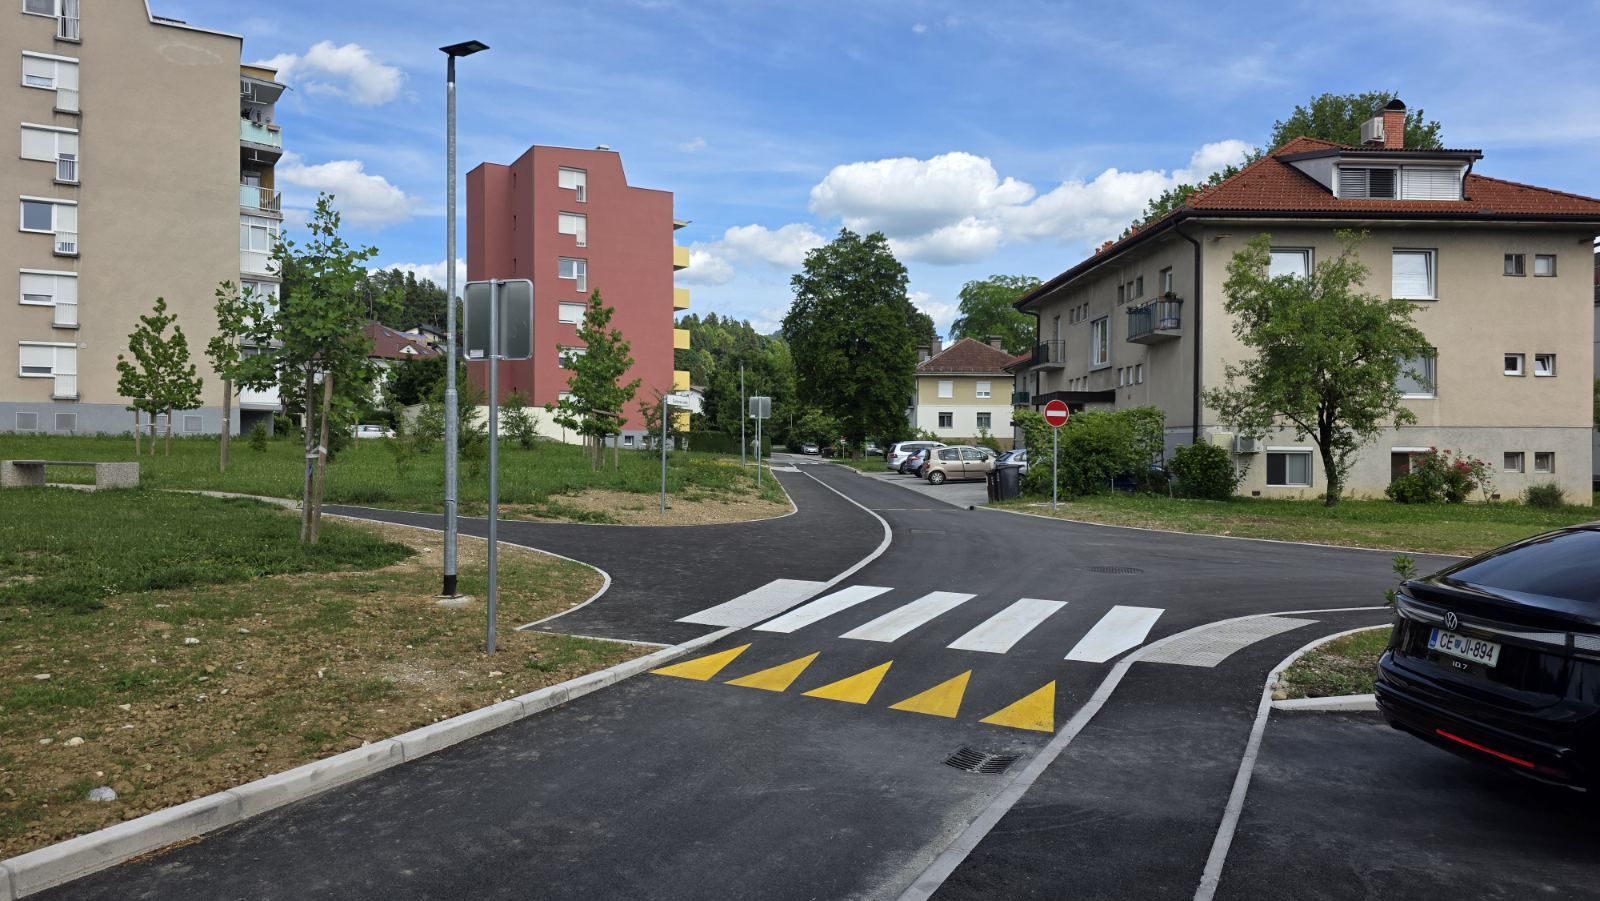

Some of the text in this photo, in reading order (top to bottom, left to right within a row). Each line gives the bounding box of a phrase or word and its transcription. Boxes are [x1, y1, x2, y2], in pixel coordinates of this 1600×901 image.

[1445, 611, 1458, 630] VW
[1440, 633, 1494, 661] CE JI-894
